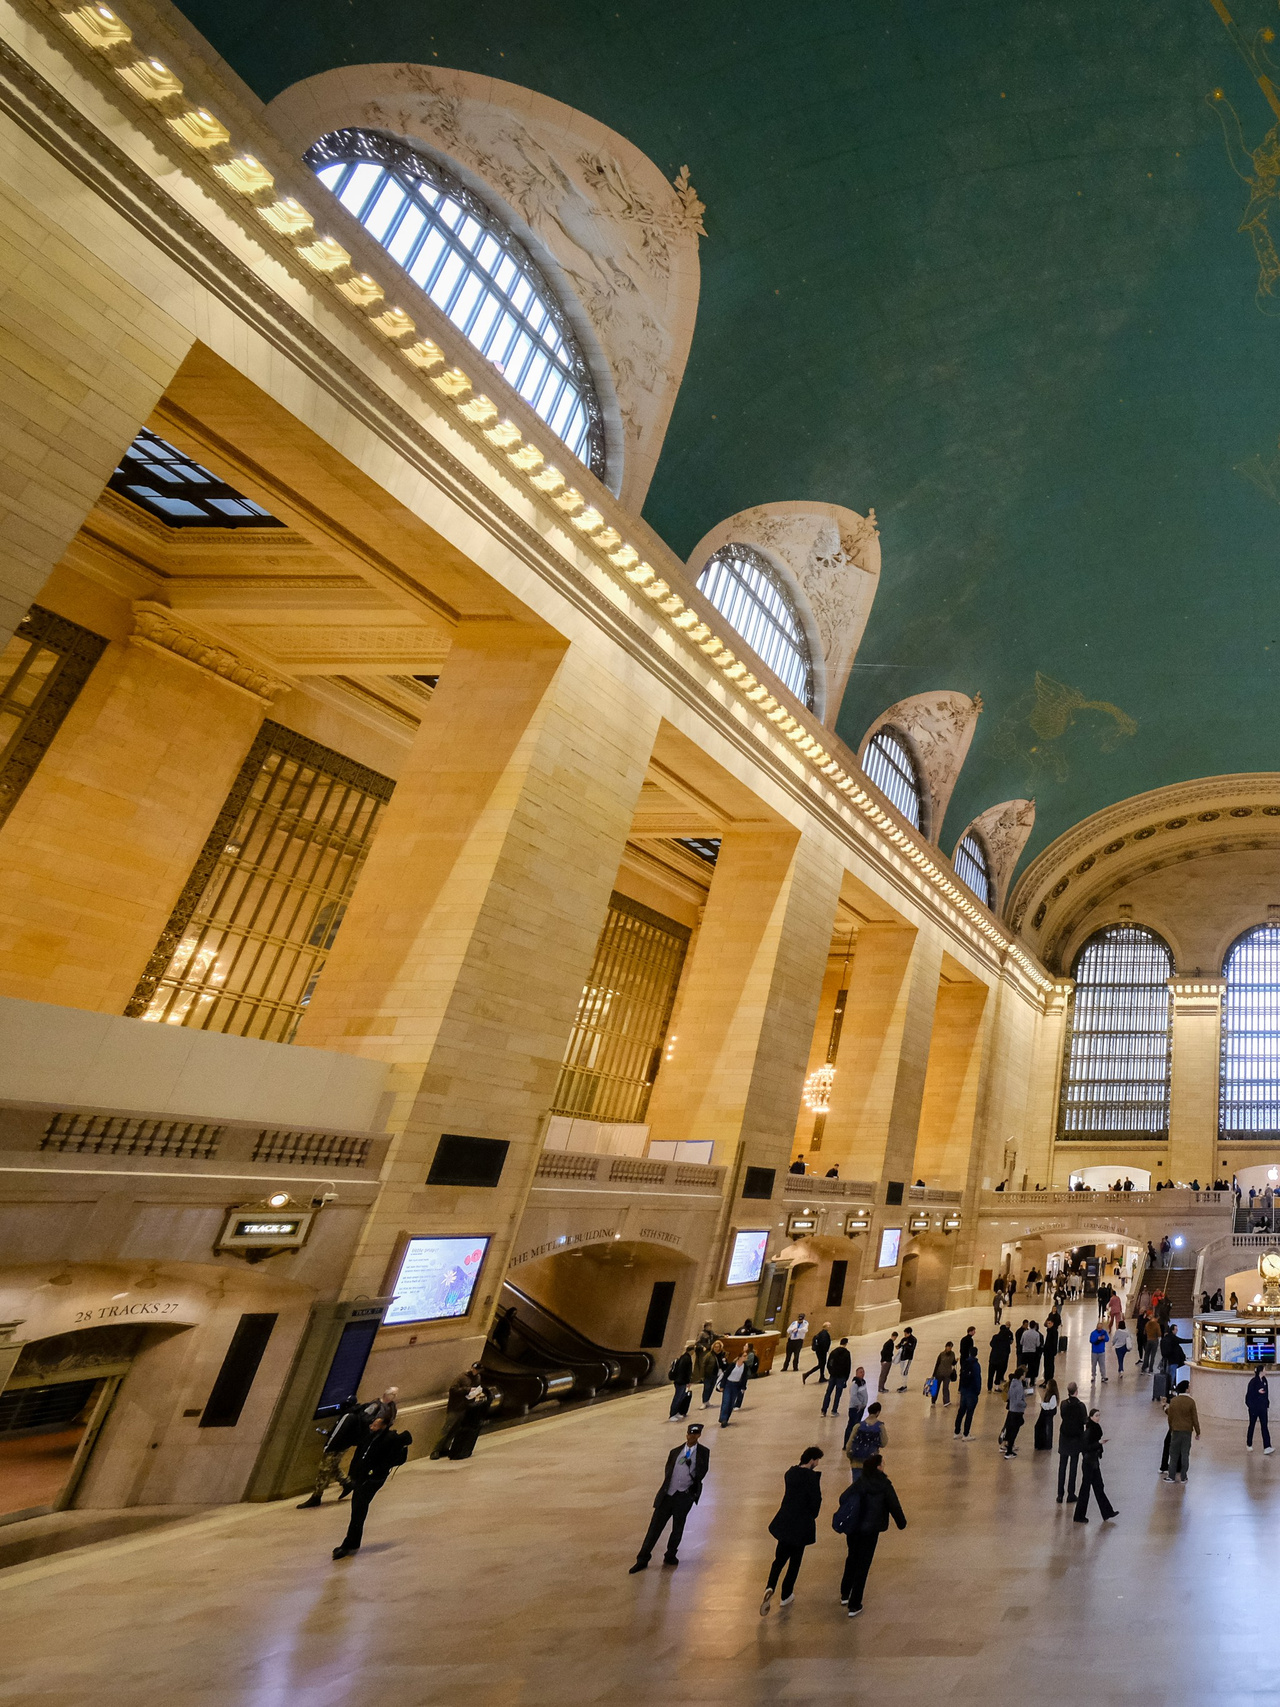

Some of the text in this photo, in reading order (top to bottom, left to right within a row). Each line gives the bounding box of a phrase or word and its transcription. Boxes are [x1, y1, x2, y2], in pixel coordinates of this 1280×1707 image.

[656, 1230, 682, 1245] STREET
[508, 1228, 615, 1269] THE METLE BUILDING
[74, 1303, 179, 1323] 28 TRACKS 27
